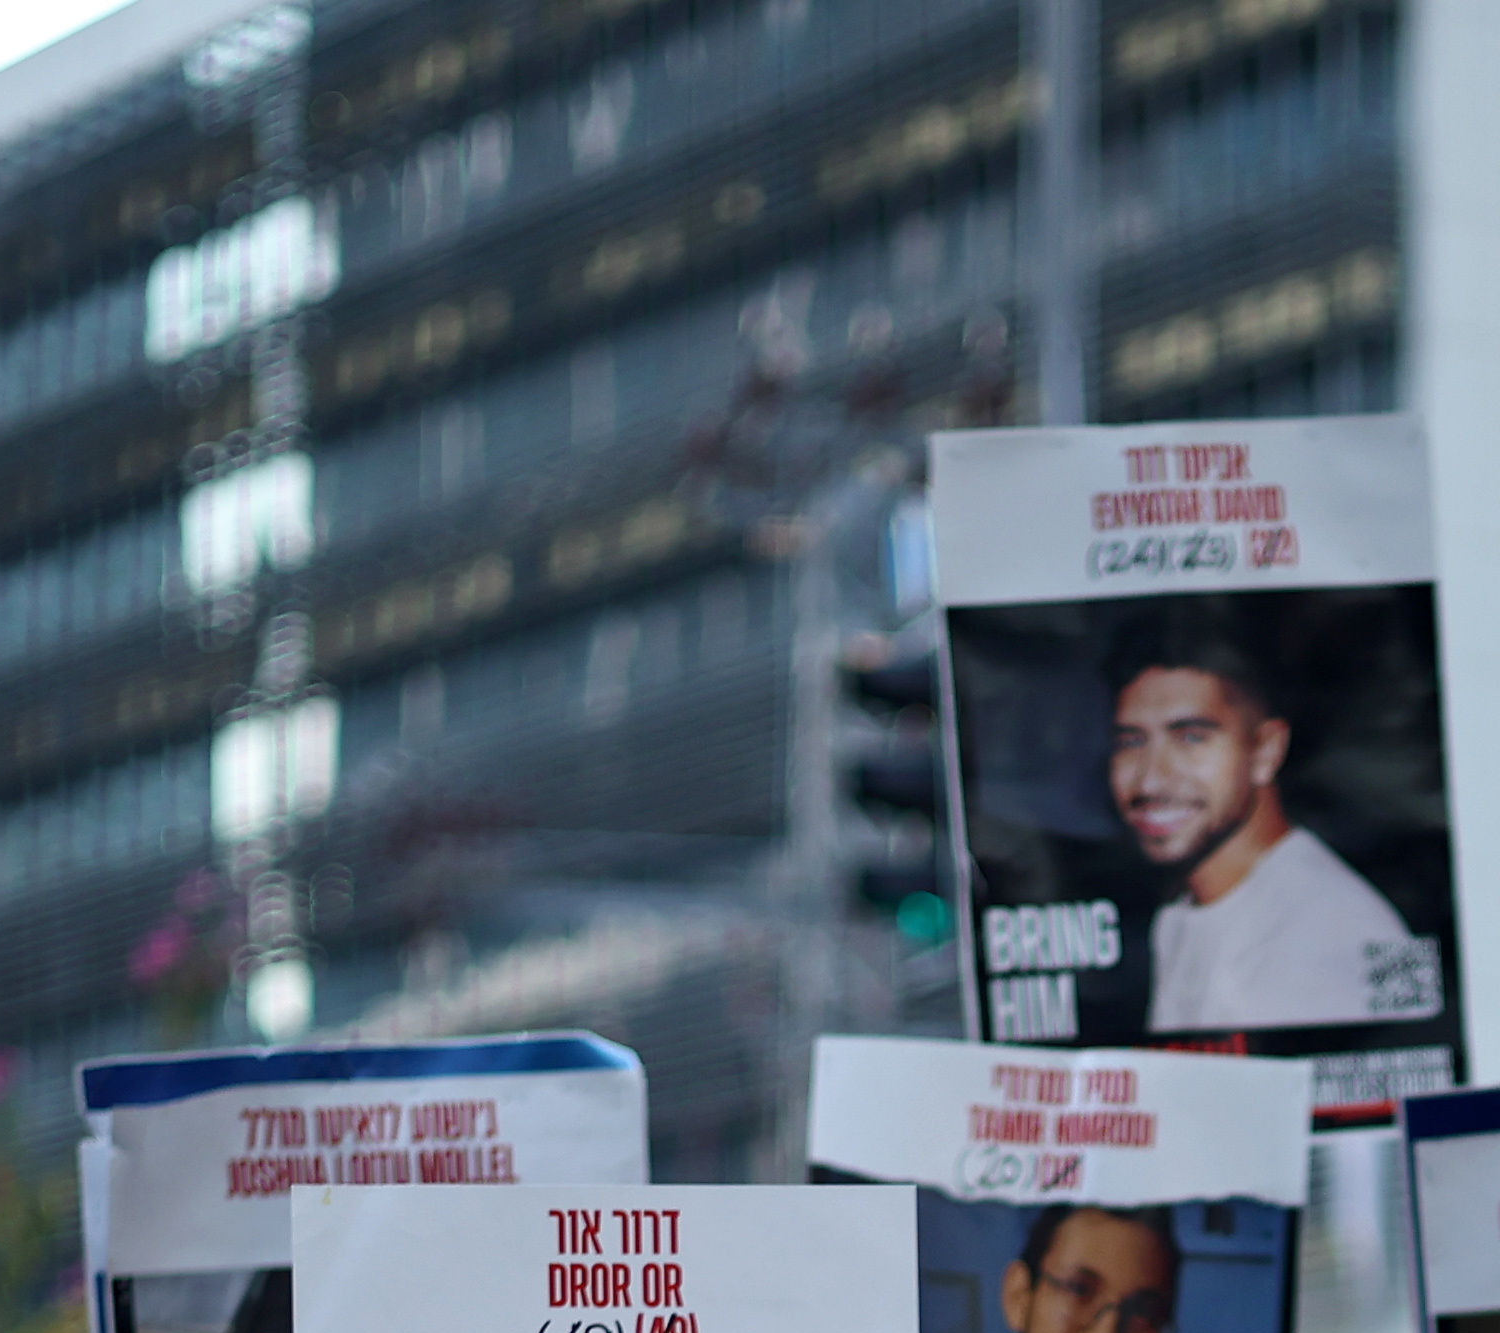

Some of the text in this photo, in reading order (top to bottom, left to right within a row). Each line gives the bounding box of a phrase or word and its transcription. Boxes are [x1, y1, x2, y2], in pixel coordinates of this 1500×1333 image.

[981, 900, 1123, 974] BRING
[988, 972, 1079, 1042] HIM
[548, 1209, 680, 1255] דרור אור
[548, 1262, 684, 1308] DROR OR
